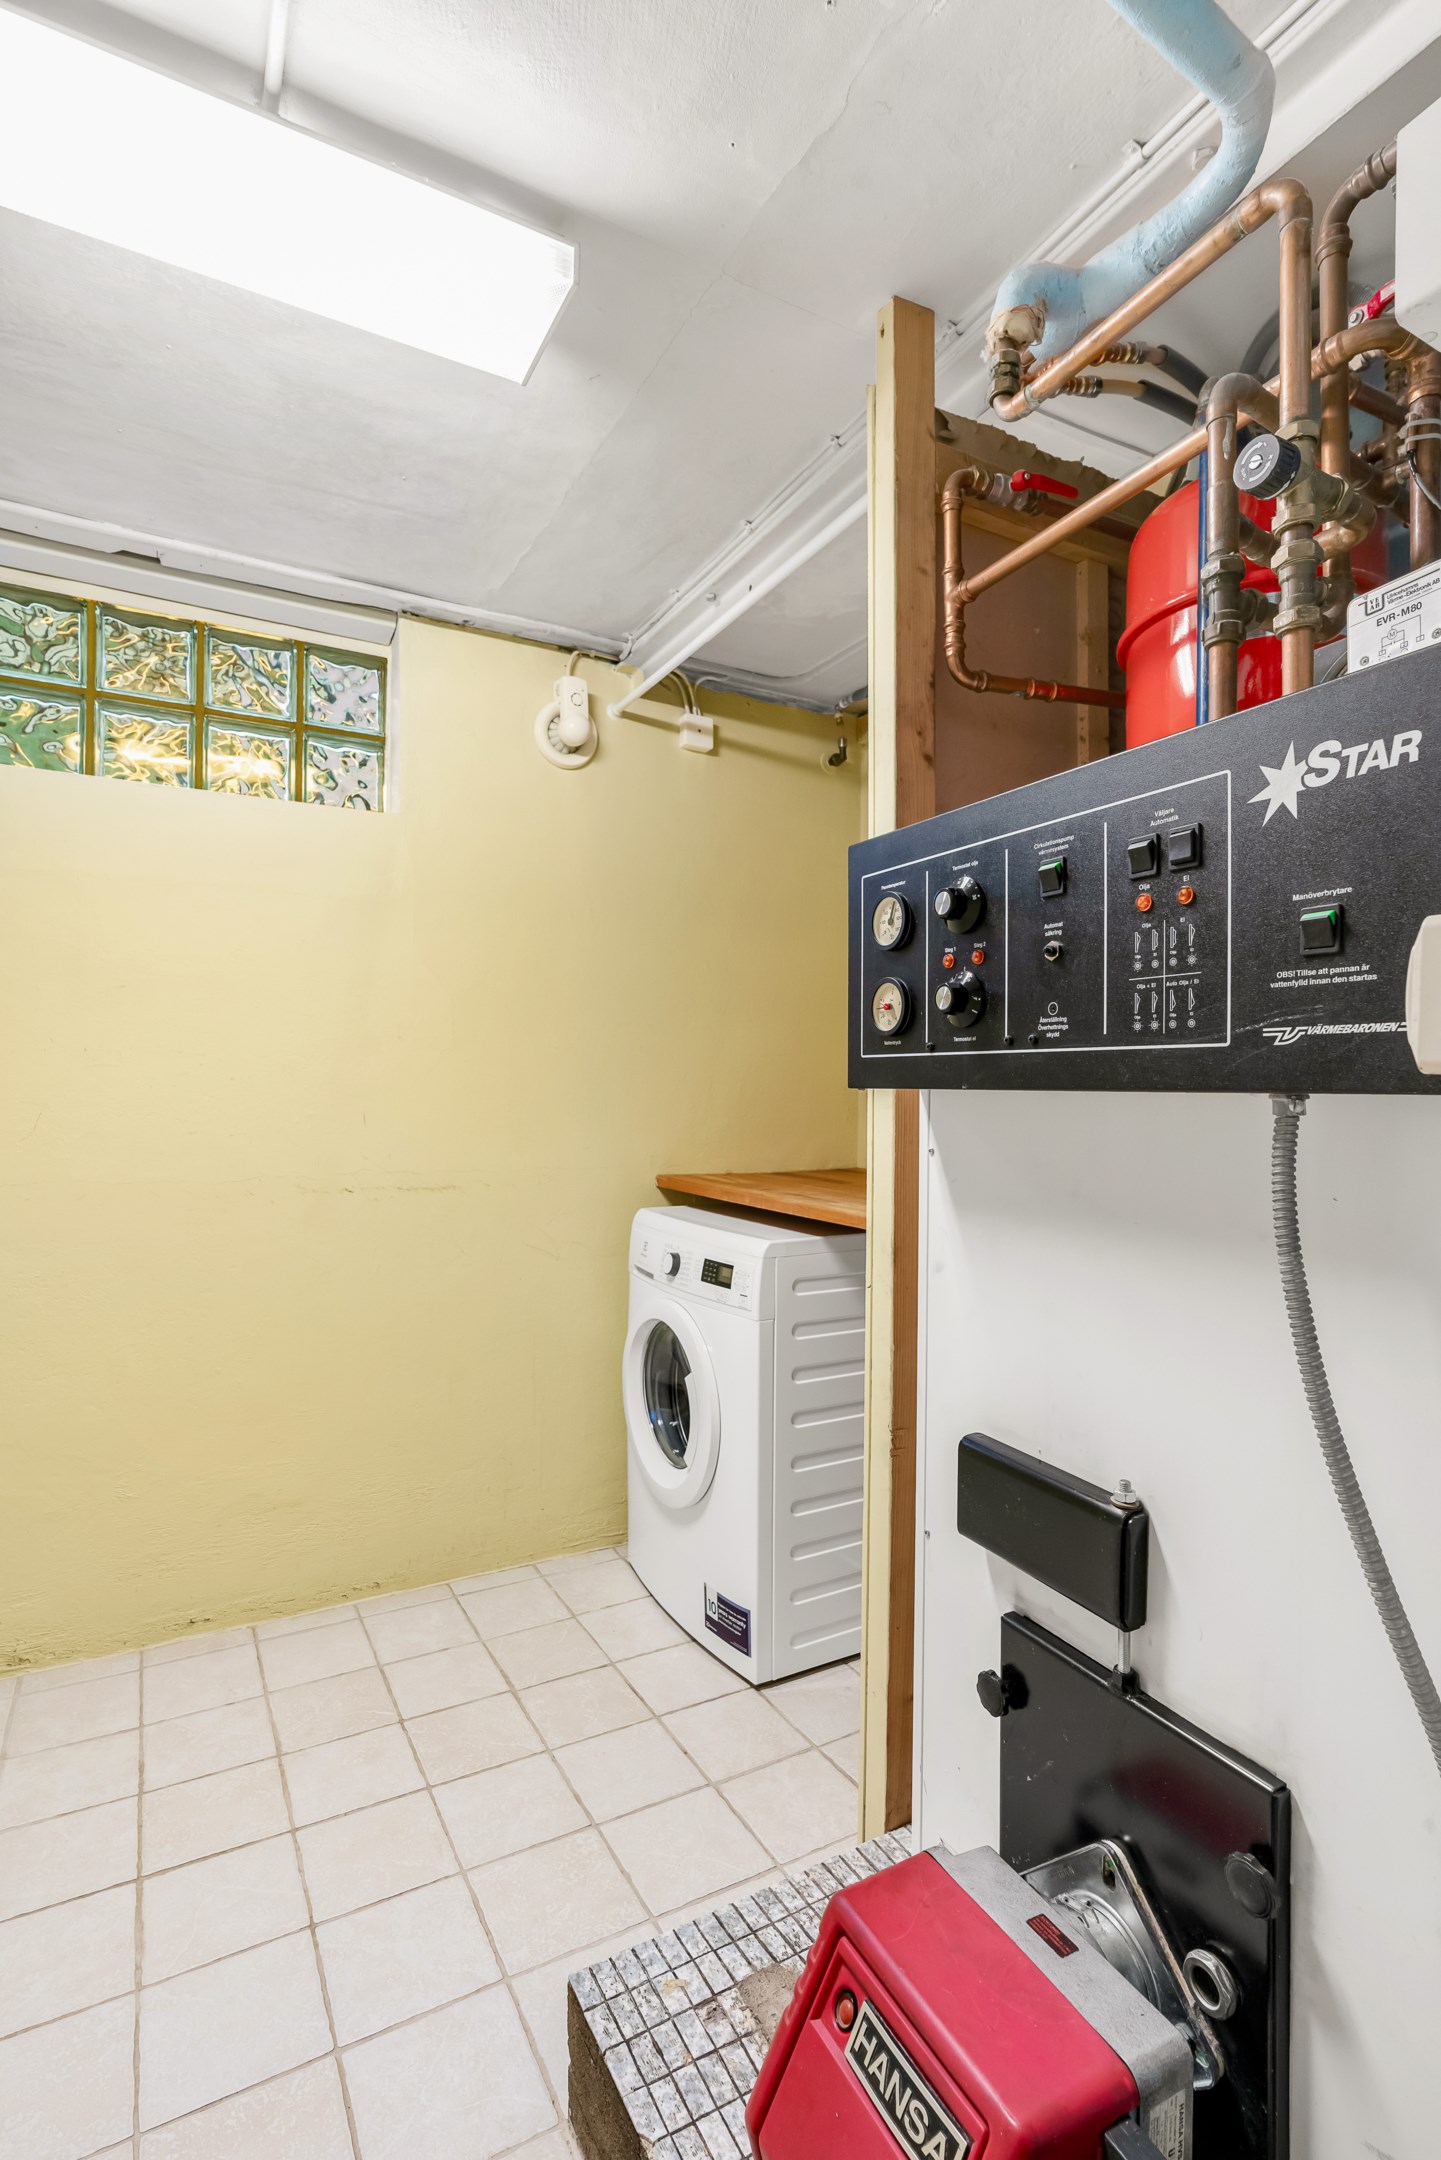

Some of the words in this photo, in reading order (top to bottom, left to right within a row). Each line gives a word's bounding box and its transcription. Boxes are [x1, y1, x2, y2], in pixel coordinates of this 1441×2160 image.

[1386, 582, 1419, 599] Ulricehamns
[1304, 730, 1422, 788] STAR
[1154, 808, 1174, 817] Väljare
[1150, 815, 1179, 827] Automatik
[1034, 835, 1074, 850] Cirkulationspump
[952, 862, 970, 871] Termostat
[1292, 886, 1352, 901] Manöverbrytare
[1276, 971, 1296, 979] OBS!
[1330, 965, 1360, 975] pannan
[1270, 979, 1308, 988] vattenfylld
[1348, 973, 1378, 981] startas
[1306, 1022, 1400, 1035] VÄRMEBARONEN
[708, 1599, 716, 1614] 10
[853, 2020, 948, 2160] HANSA
